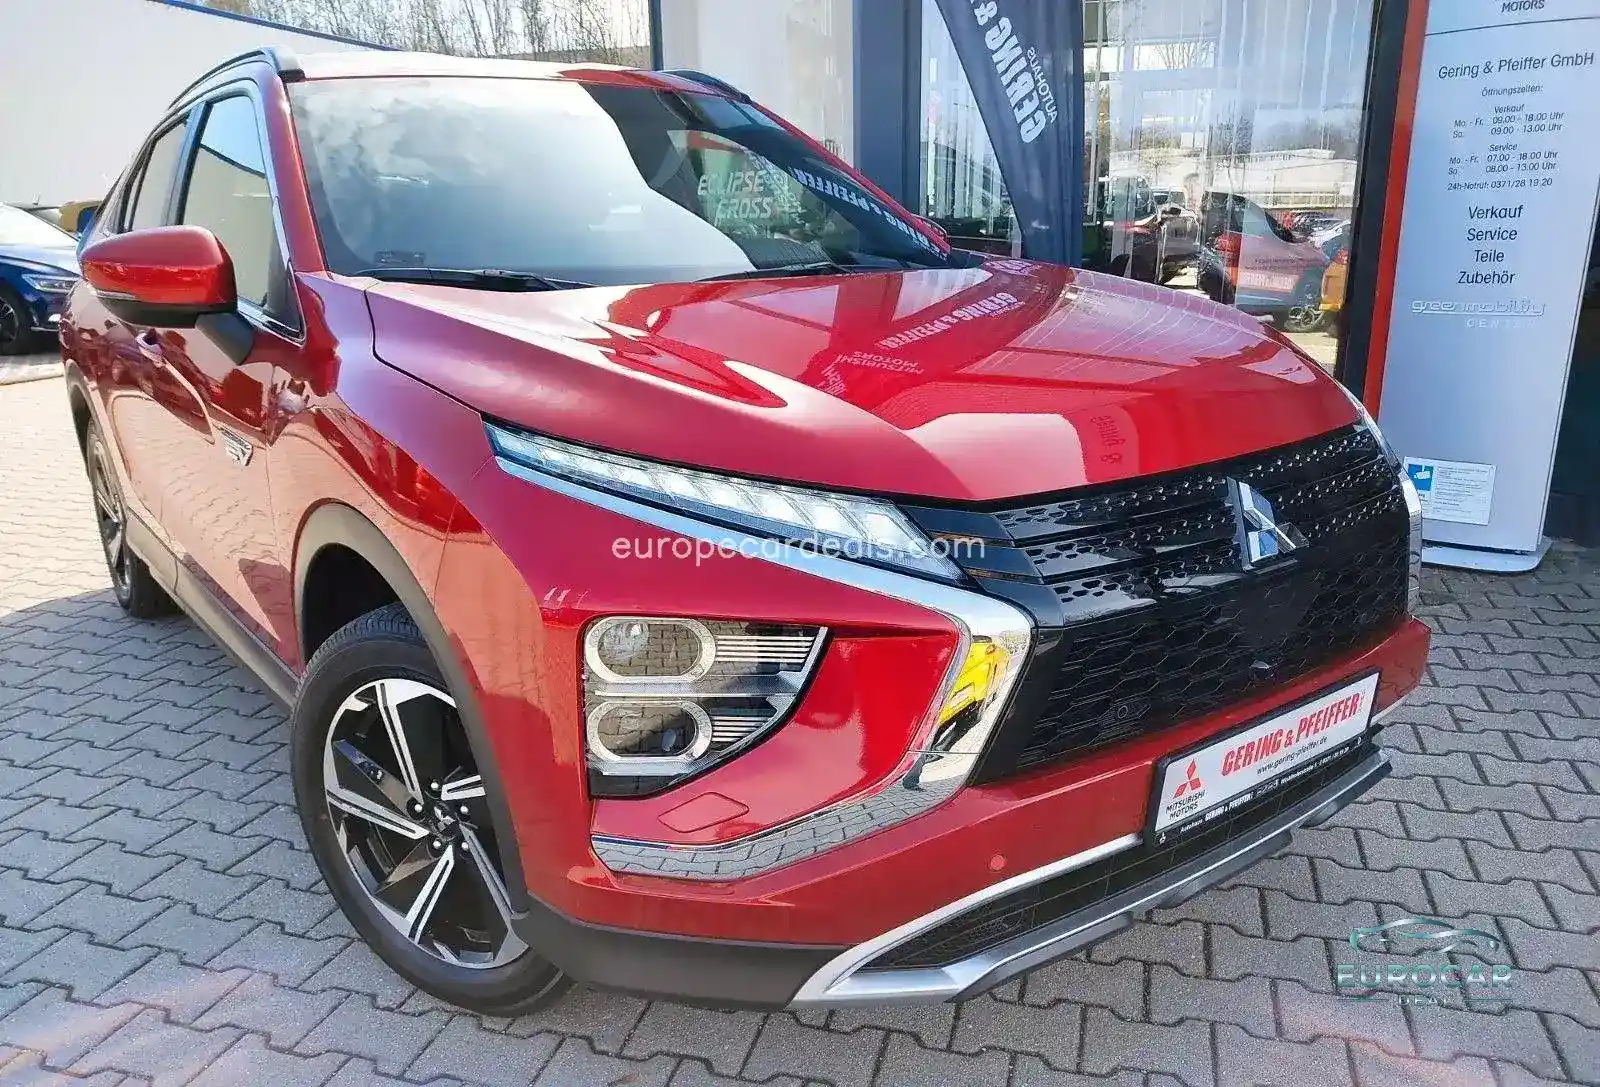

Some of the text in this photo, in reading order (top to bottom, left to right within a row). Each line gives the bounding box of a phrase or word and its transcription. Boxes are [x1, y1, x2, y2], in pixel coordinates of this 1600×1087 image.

[1501, 0, 1545, 13] MOTORS
[1438, 51, 1595, 79] Gering & Pfeiffer GmbH
[1494, 104, 1525, 114] Verkauf
[1524, 112, 1548, 122] 18.00
[1550, 112, 1565, 120] Uhr
[1523, 124, 1546, 133] 13.00
[1548, 123, 1563, 132] Uhr
[1489, 143, 1518, 152] Service
[1487, 153, 1510, 162] 07.00
[1519, 152, 1542, 161] 18.00
[1543, 151, 1559, 159] Uhr
[1485, 164, 1509, 173] 08.00
[1517, 162, 1540, 172] 13.00
[1541, 161, 1557, 170] Uhr
[1447, 177, 1553, 191] 24h-Notruf: 0371/28 19 20
[1468, 204, 1524, 219] Verkauf
[1466, 227, 1518, 242] Service
[1474, 249, 1505, 263] Teile
[1458, 269, 1516, 284] Zubehör
[1221, 728, 1285, 777] GERING
[1283, 729, 1295, 748] &
[1295, 692, 1361, 743] PFEIFFER
[1165, 789, 1206, 814] MITSUBISHI
[1169, 801, 1200, 820] MOTORS
